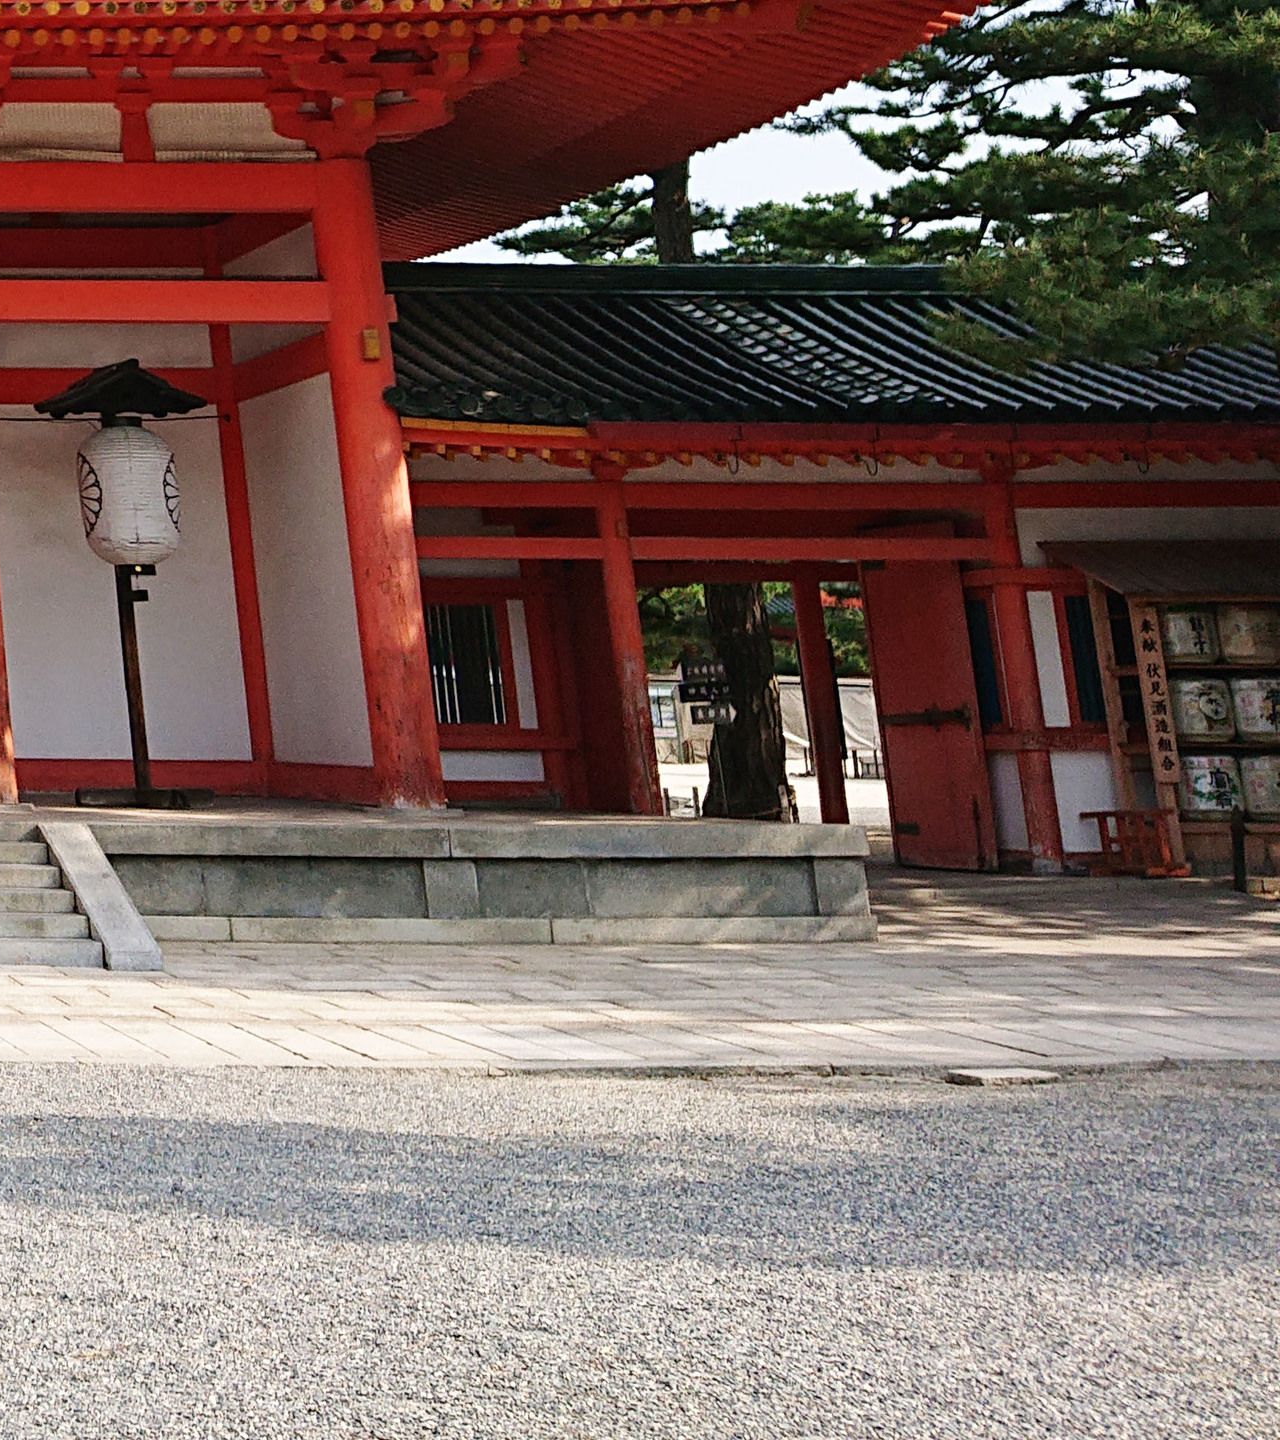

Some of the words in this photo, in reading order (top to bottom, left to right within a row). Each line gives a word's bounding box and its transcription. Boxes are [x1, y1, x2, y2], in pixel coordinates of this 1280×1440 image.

[1140, 618, 1159, 653] 奉献
[1146, 663, 1176, 772] 伏見酒造組合
